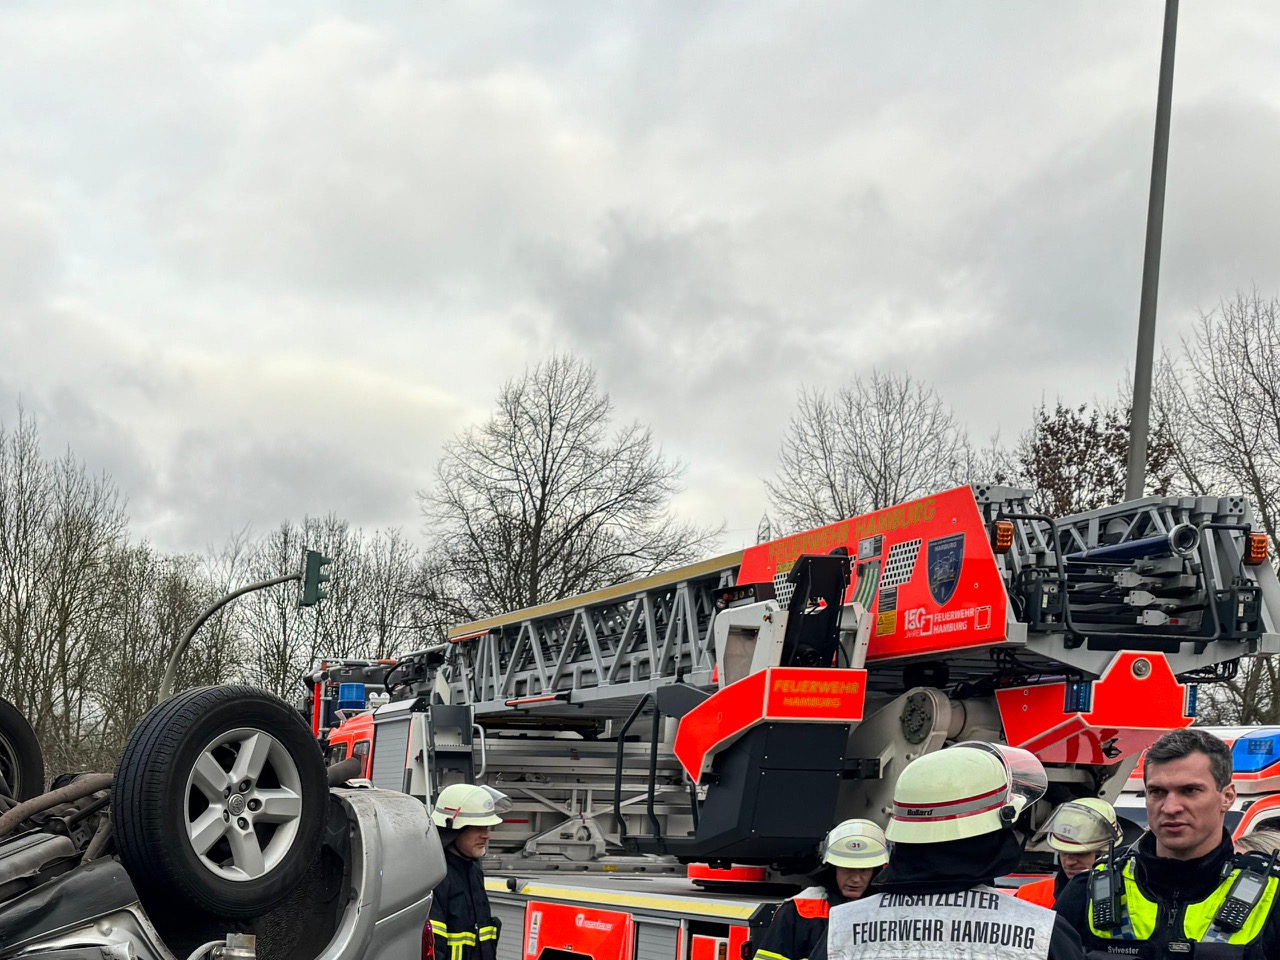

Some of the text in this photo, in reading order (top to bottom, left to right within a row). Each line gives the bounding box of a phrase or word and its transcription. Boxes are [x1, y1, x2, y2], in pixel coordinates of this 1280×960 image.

[770, 523, 850, 561] FEUERWEHR
[855, 499, 936, 539] HAMBURG
[933, 607, 975, 622] FEUERWEHR
[932, 621, 968, 635] HAMBURG
[773, 680, 860, 694] FEUERWEHR
[783, 697, 841, 708] HAMBURG
[853, 919, 1035, 950] FEUERWEHR HAMBURG
[1107, 945, 1139, 955] Sylvester
